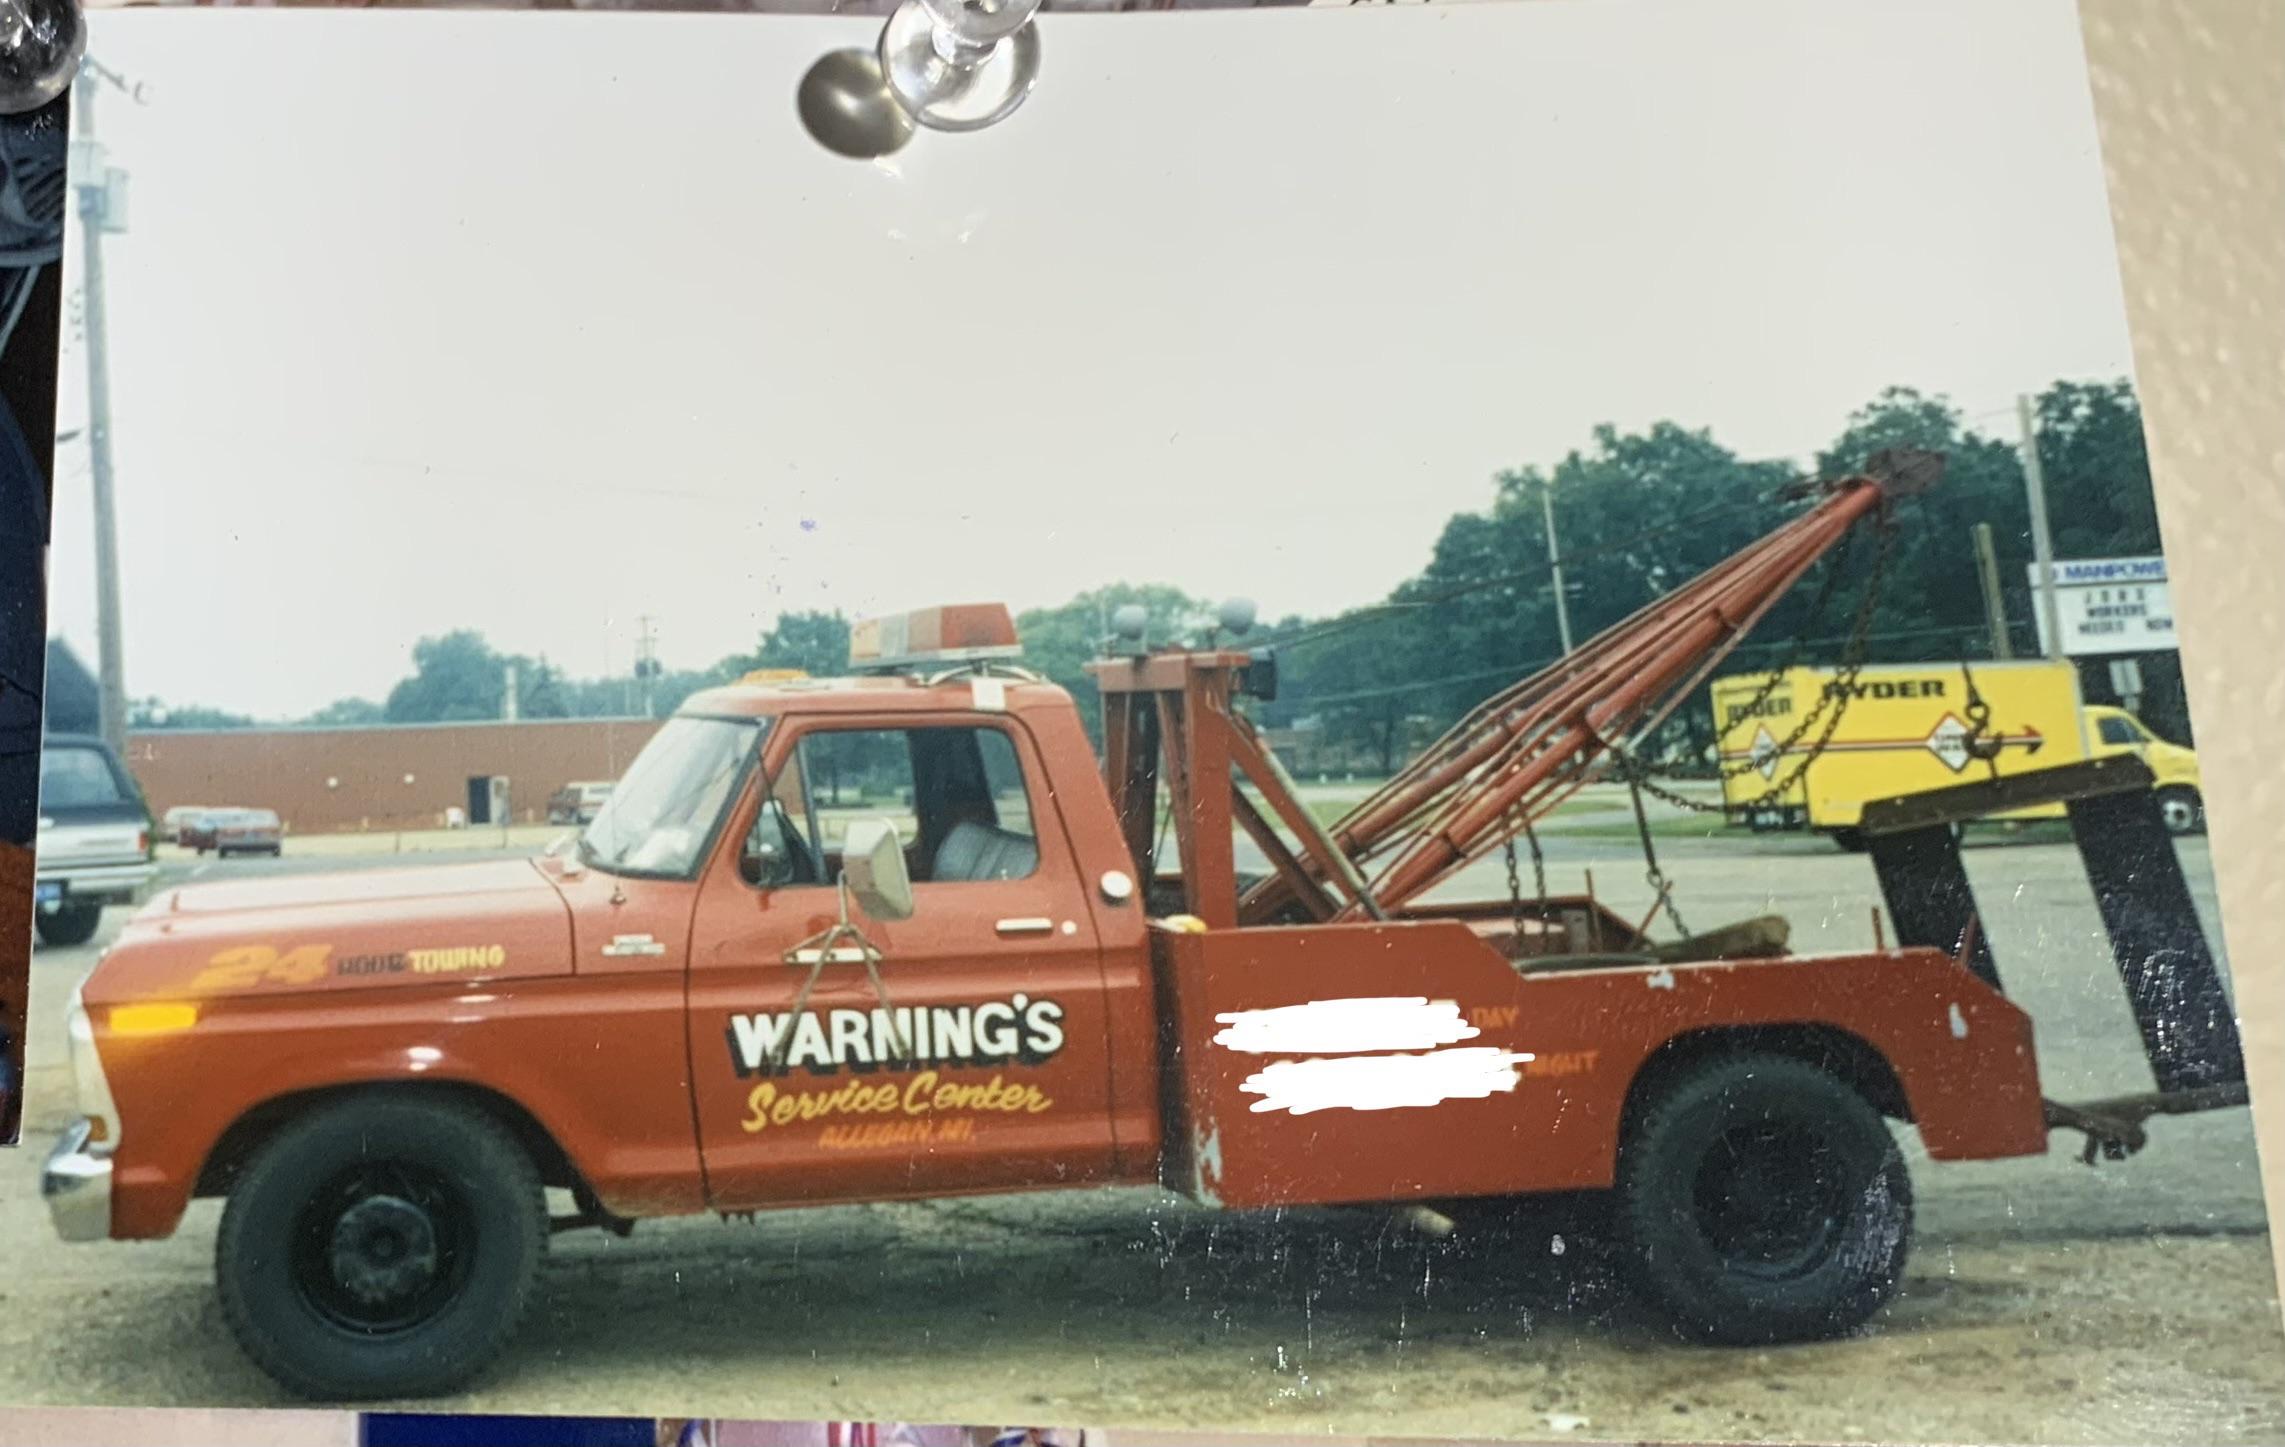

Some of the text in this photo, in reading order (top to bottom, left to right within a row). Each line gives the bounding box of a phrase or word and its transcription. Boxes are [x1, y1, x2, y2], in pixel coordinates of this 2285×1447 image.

[190, 944, 332, 990] 24
[408, 945, 505, 974] TOWING
[727, 993, 1064, 1077] WARNING'S
[1471, 1006, 1519, 1028] DAY
[741, 1070, 1053, 1133] Service Center
